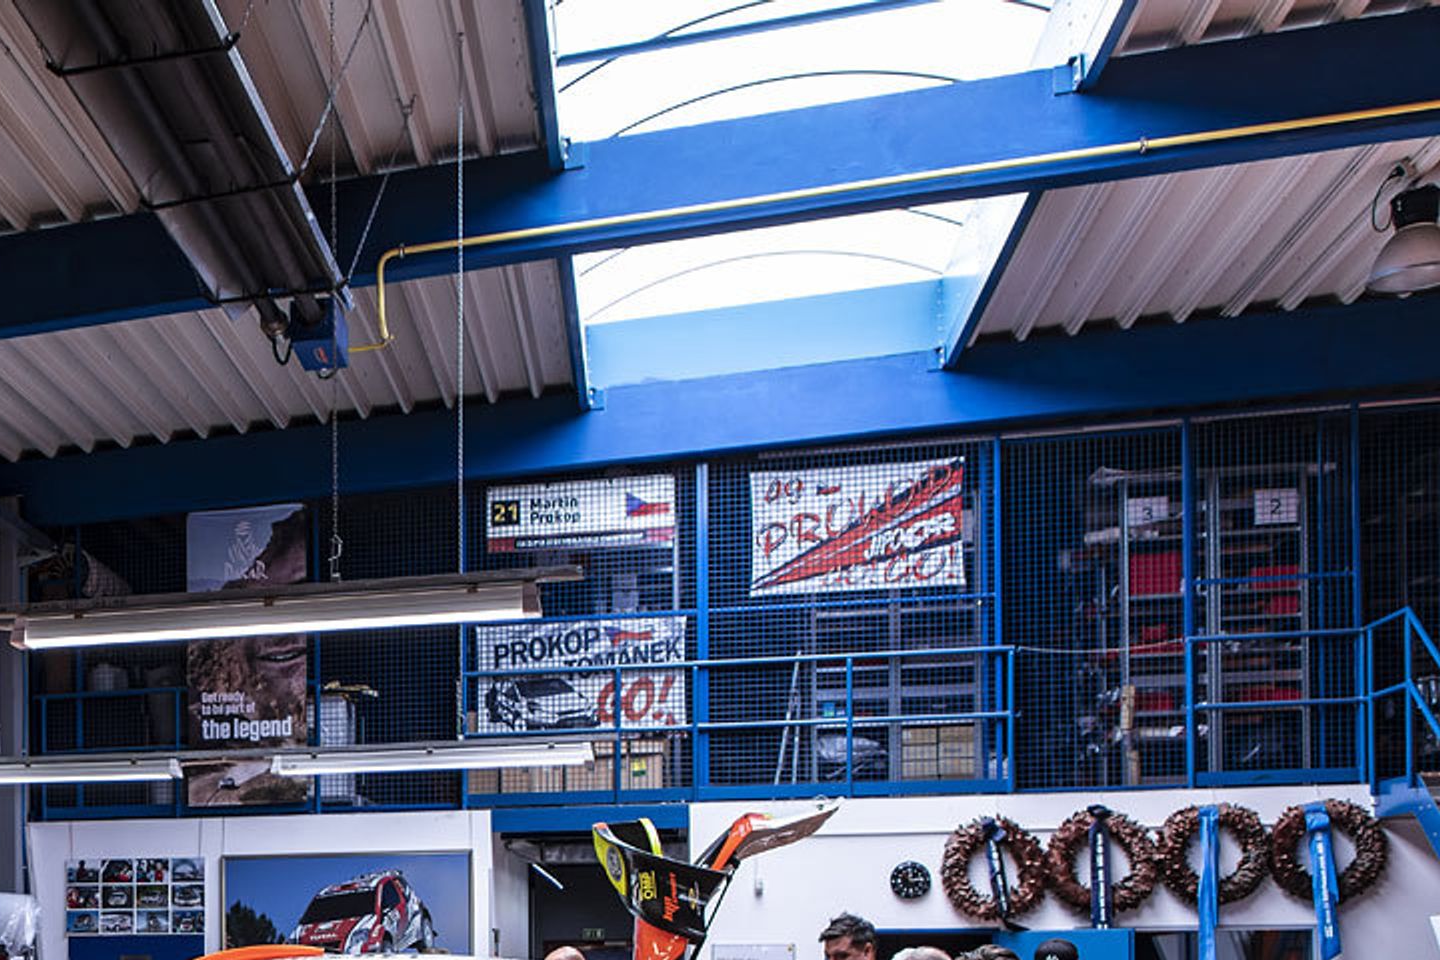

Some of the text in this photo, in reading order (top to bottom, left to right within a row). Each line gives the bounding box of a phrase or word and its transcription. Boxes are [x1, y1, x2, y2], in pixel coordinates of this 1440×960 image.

[529, 496, 578, 511] Martin
[1269, 498, 1282, 515] 2
[492, 503, 517, 523] 21
[529, 510, 581, 525] Prokop
[1142, 507, 1154, 520] 3
[494, 626, 600, 669] PROKOP
[563, 636, 682, 680] TOMÁNEK
[201, 691, 246, 706] Get ready
[201, 704, 210, 715] to
[226, 703, 245, 718] part
[247, 702, 256, 714] of
[202, 715, 293, 742] the legend
